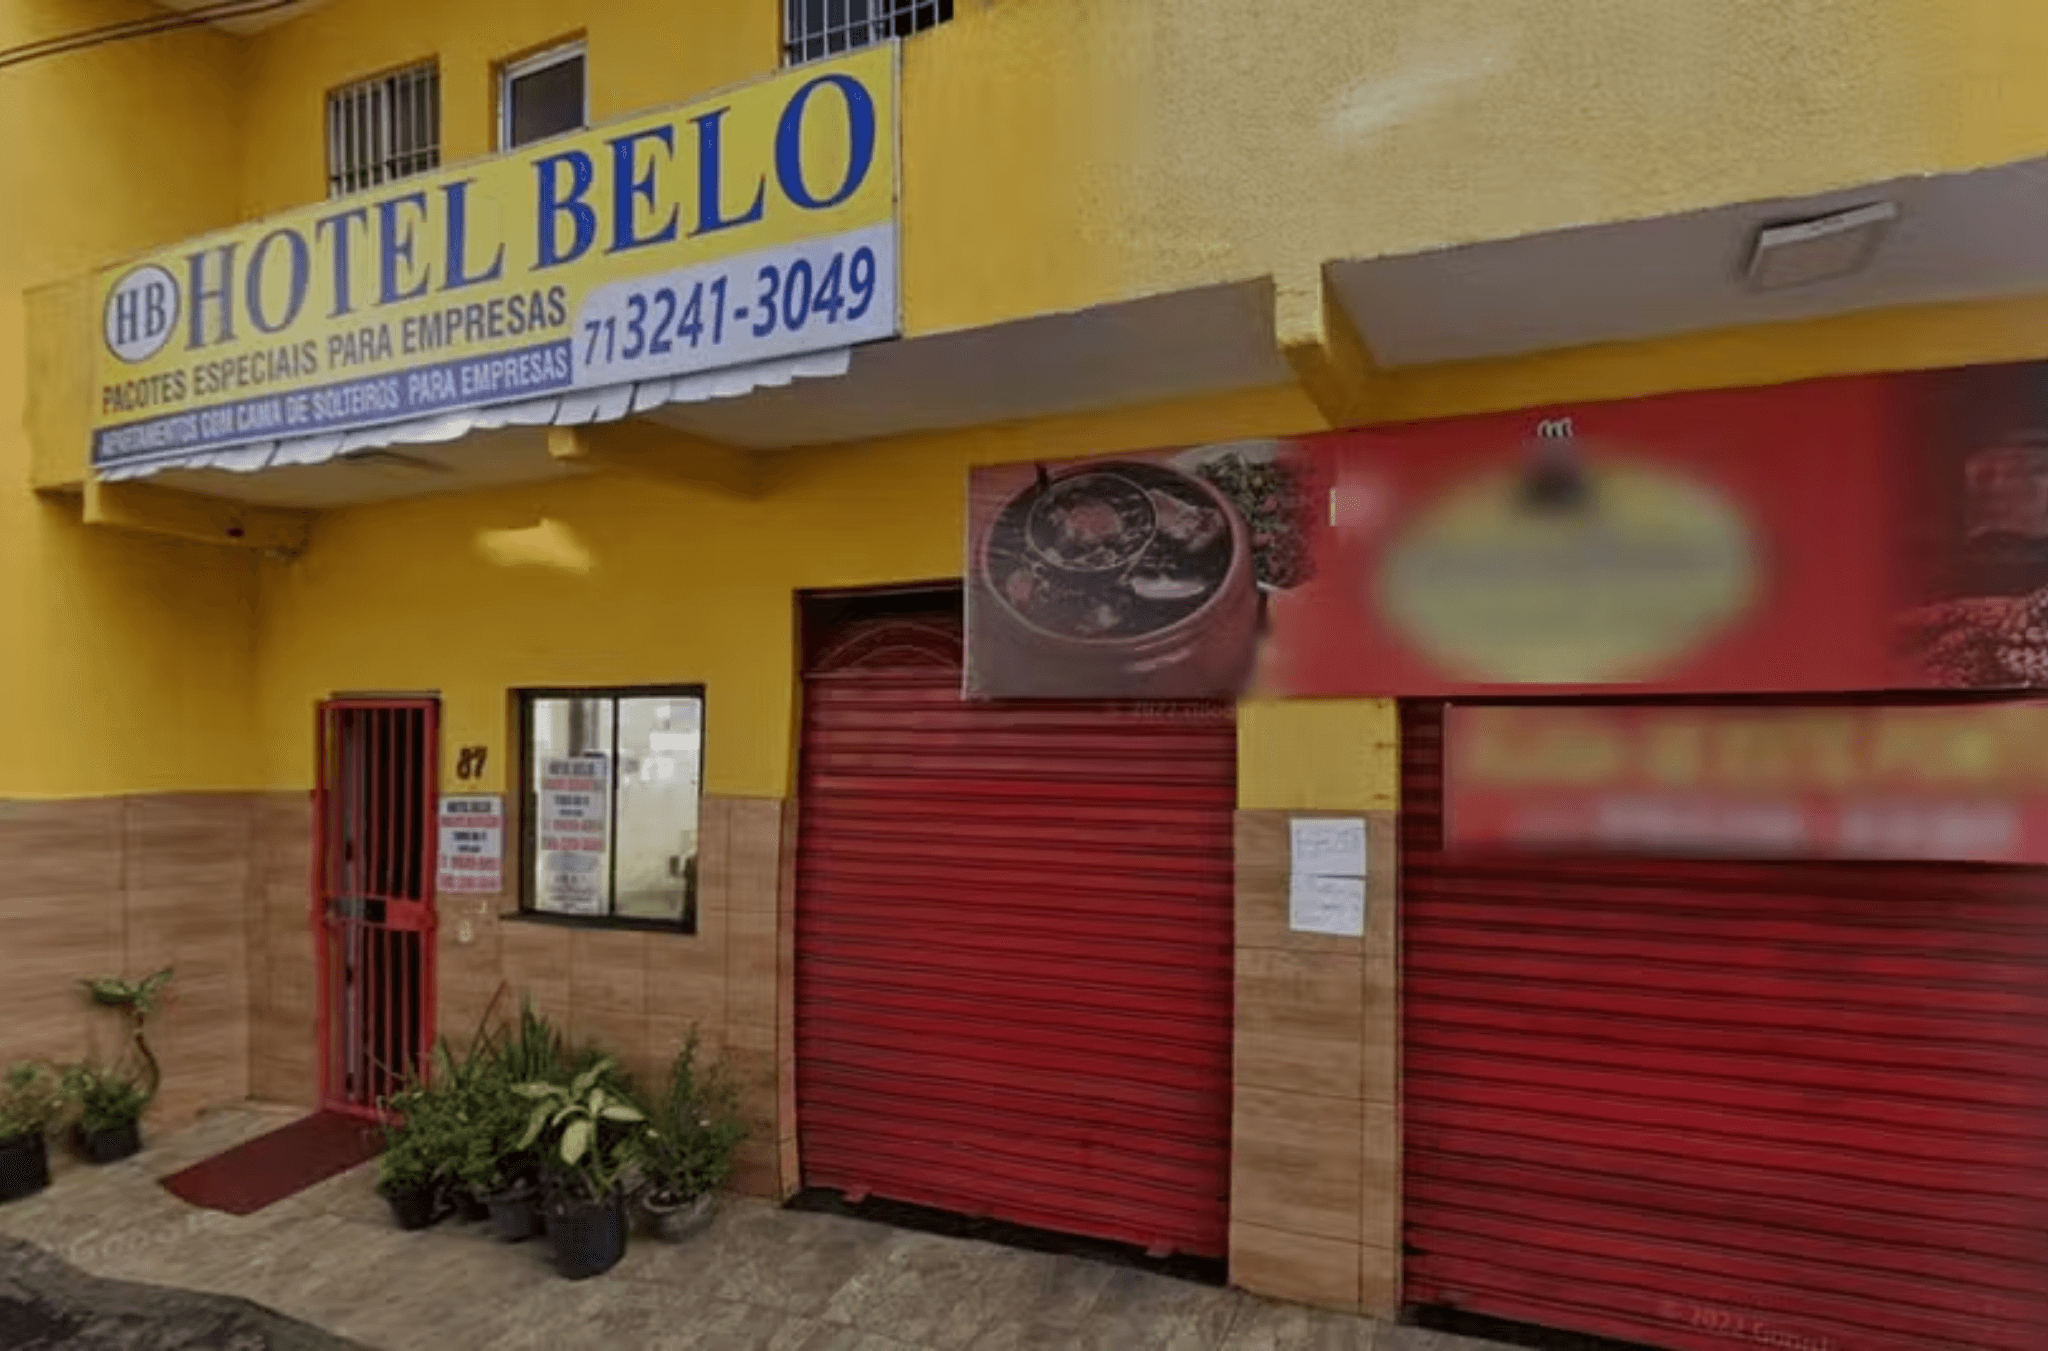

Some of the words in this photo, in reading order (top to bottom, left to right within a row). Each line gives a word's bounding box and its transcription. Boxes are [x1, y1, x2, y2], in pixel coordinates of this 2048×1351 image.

[184, 178, 506, 352] HOTEL
[528, 73, 876, 272] BELO
[103, 368, 187, 416] PACOTES
[193, 339, 318, 396] ESPECIAIS
[327, 323, 393, 370] PARA
[401, 284, 567, 355] EMPRESAS
[114, 281, 168, 346] HB
[584, 314, 617, 367] 71
[622, 245, 876, 361] 3241-3049
[286, 393, 309, 425] DE
[313, 377, 399, 421] SOLTEIROS
[408, 367, 456, 406] PARA
[461, 345, 569, 396] EMPRESAS
[456, 745, 489, 781] 87
